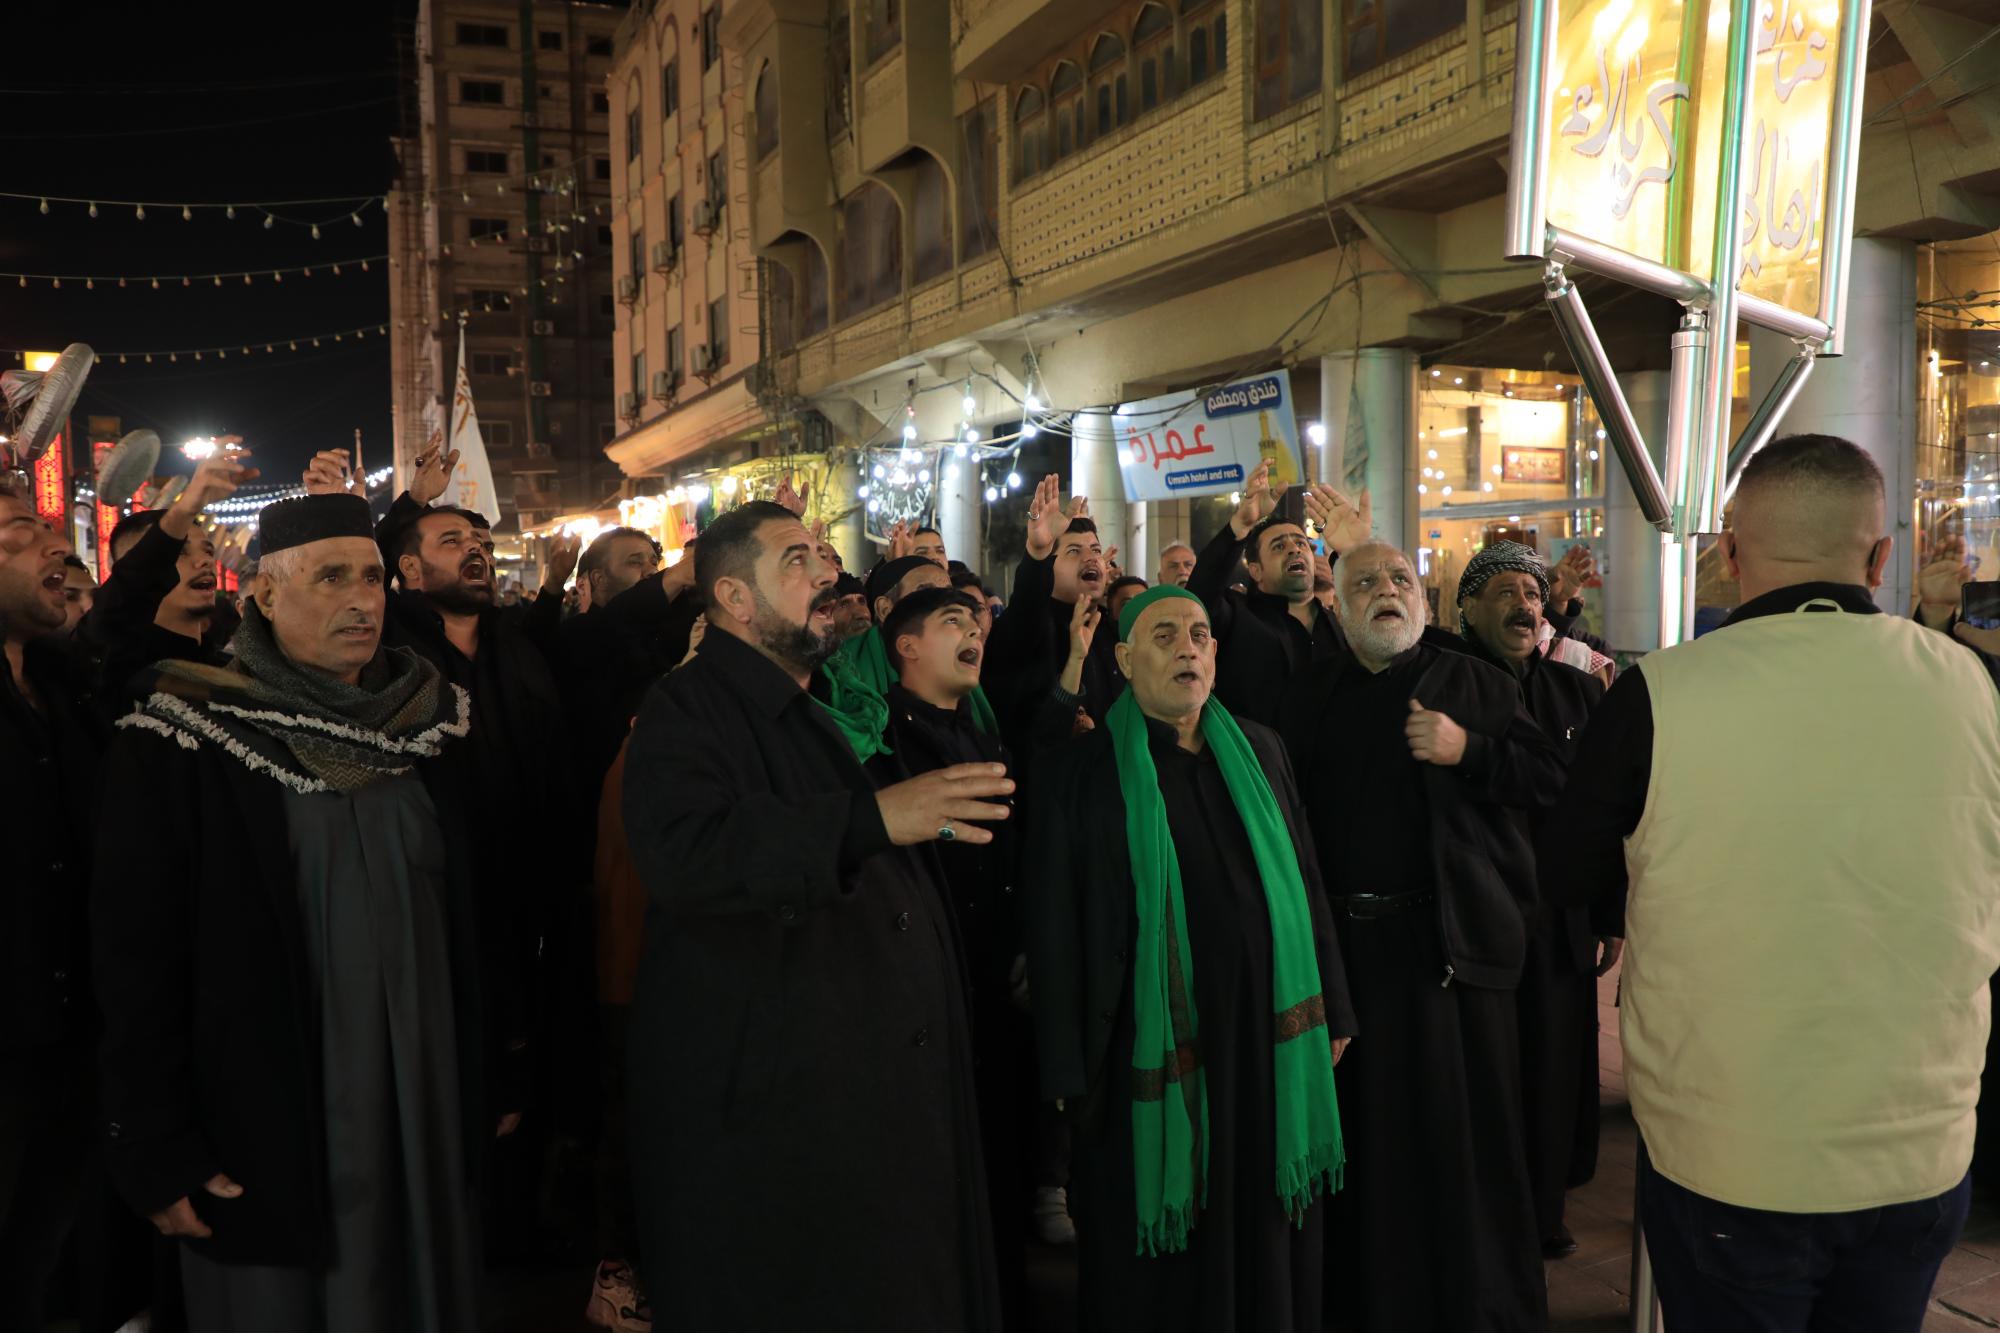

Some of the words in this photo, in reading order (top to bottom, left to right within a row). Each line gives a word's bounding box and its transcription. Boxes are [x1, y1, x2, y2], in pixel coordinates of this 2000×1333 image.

[1560, 44, 1690, 221] كربلاء
[1207, 390, 1247, 413] ومطعم
[1249, 380, 1278, 405] فندق
[1128, 424, 1214, 470] عمرة
[1168, 475, 1190, 486] Umrah
[1191, 472, 1208, 482] hotel
[1209, 469, 1222, 480] and
